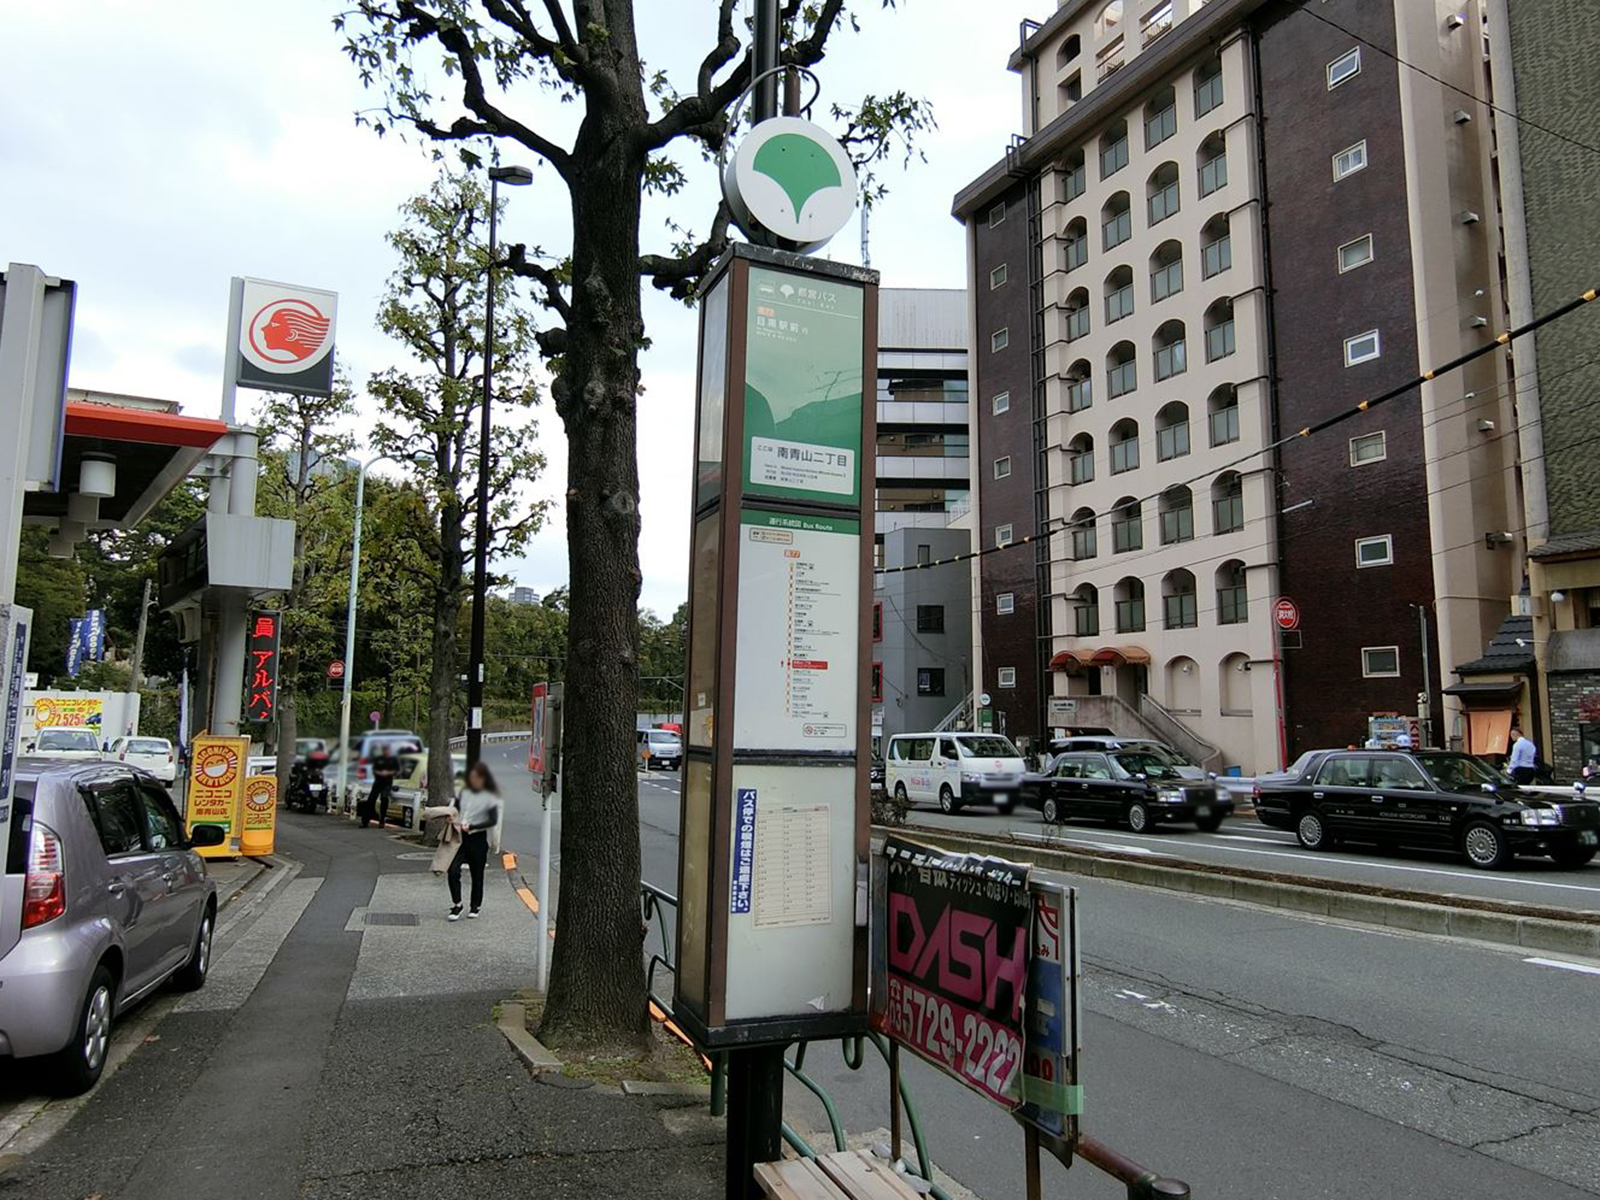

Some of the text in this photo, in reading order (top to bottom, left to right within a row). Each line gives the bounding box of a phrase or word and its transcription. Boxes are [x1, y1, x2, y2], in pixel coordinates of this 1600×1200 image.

[777, 446, 847, 467] 南青山二丁目
[803, 521, 814, 530] Bus
[815, 523, 833, 531] Route
[252, 617, 274, 638] 員
[194, 790, 232, 798] ニコニコ
[889, 892, 1027, 1022] DASH
[903, 985, 1021, 1094] 5729-2222
